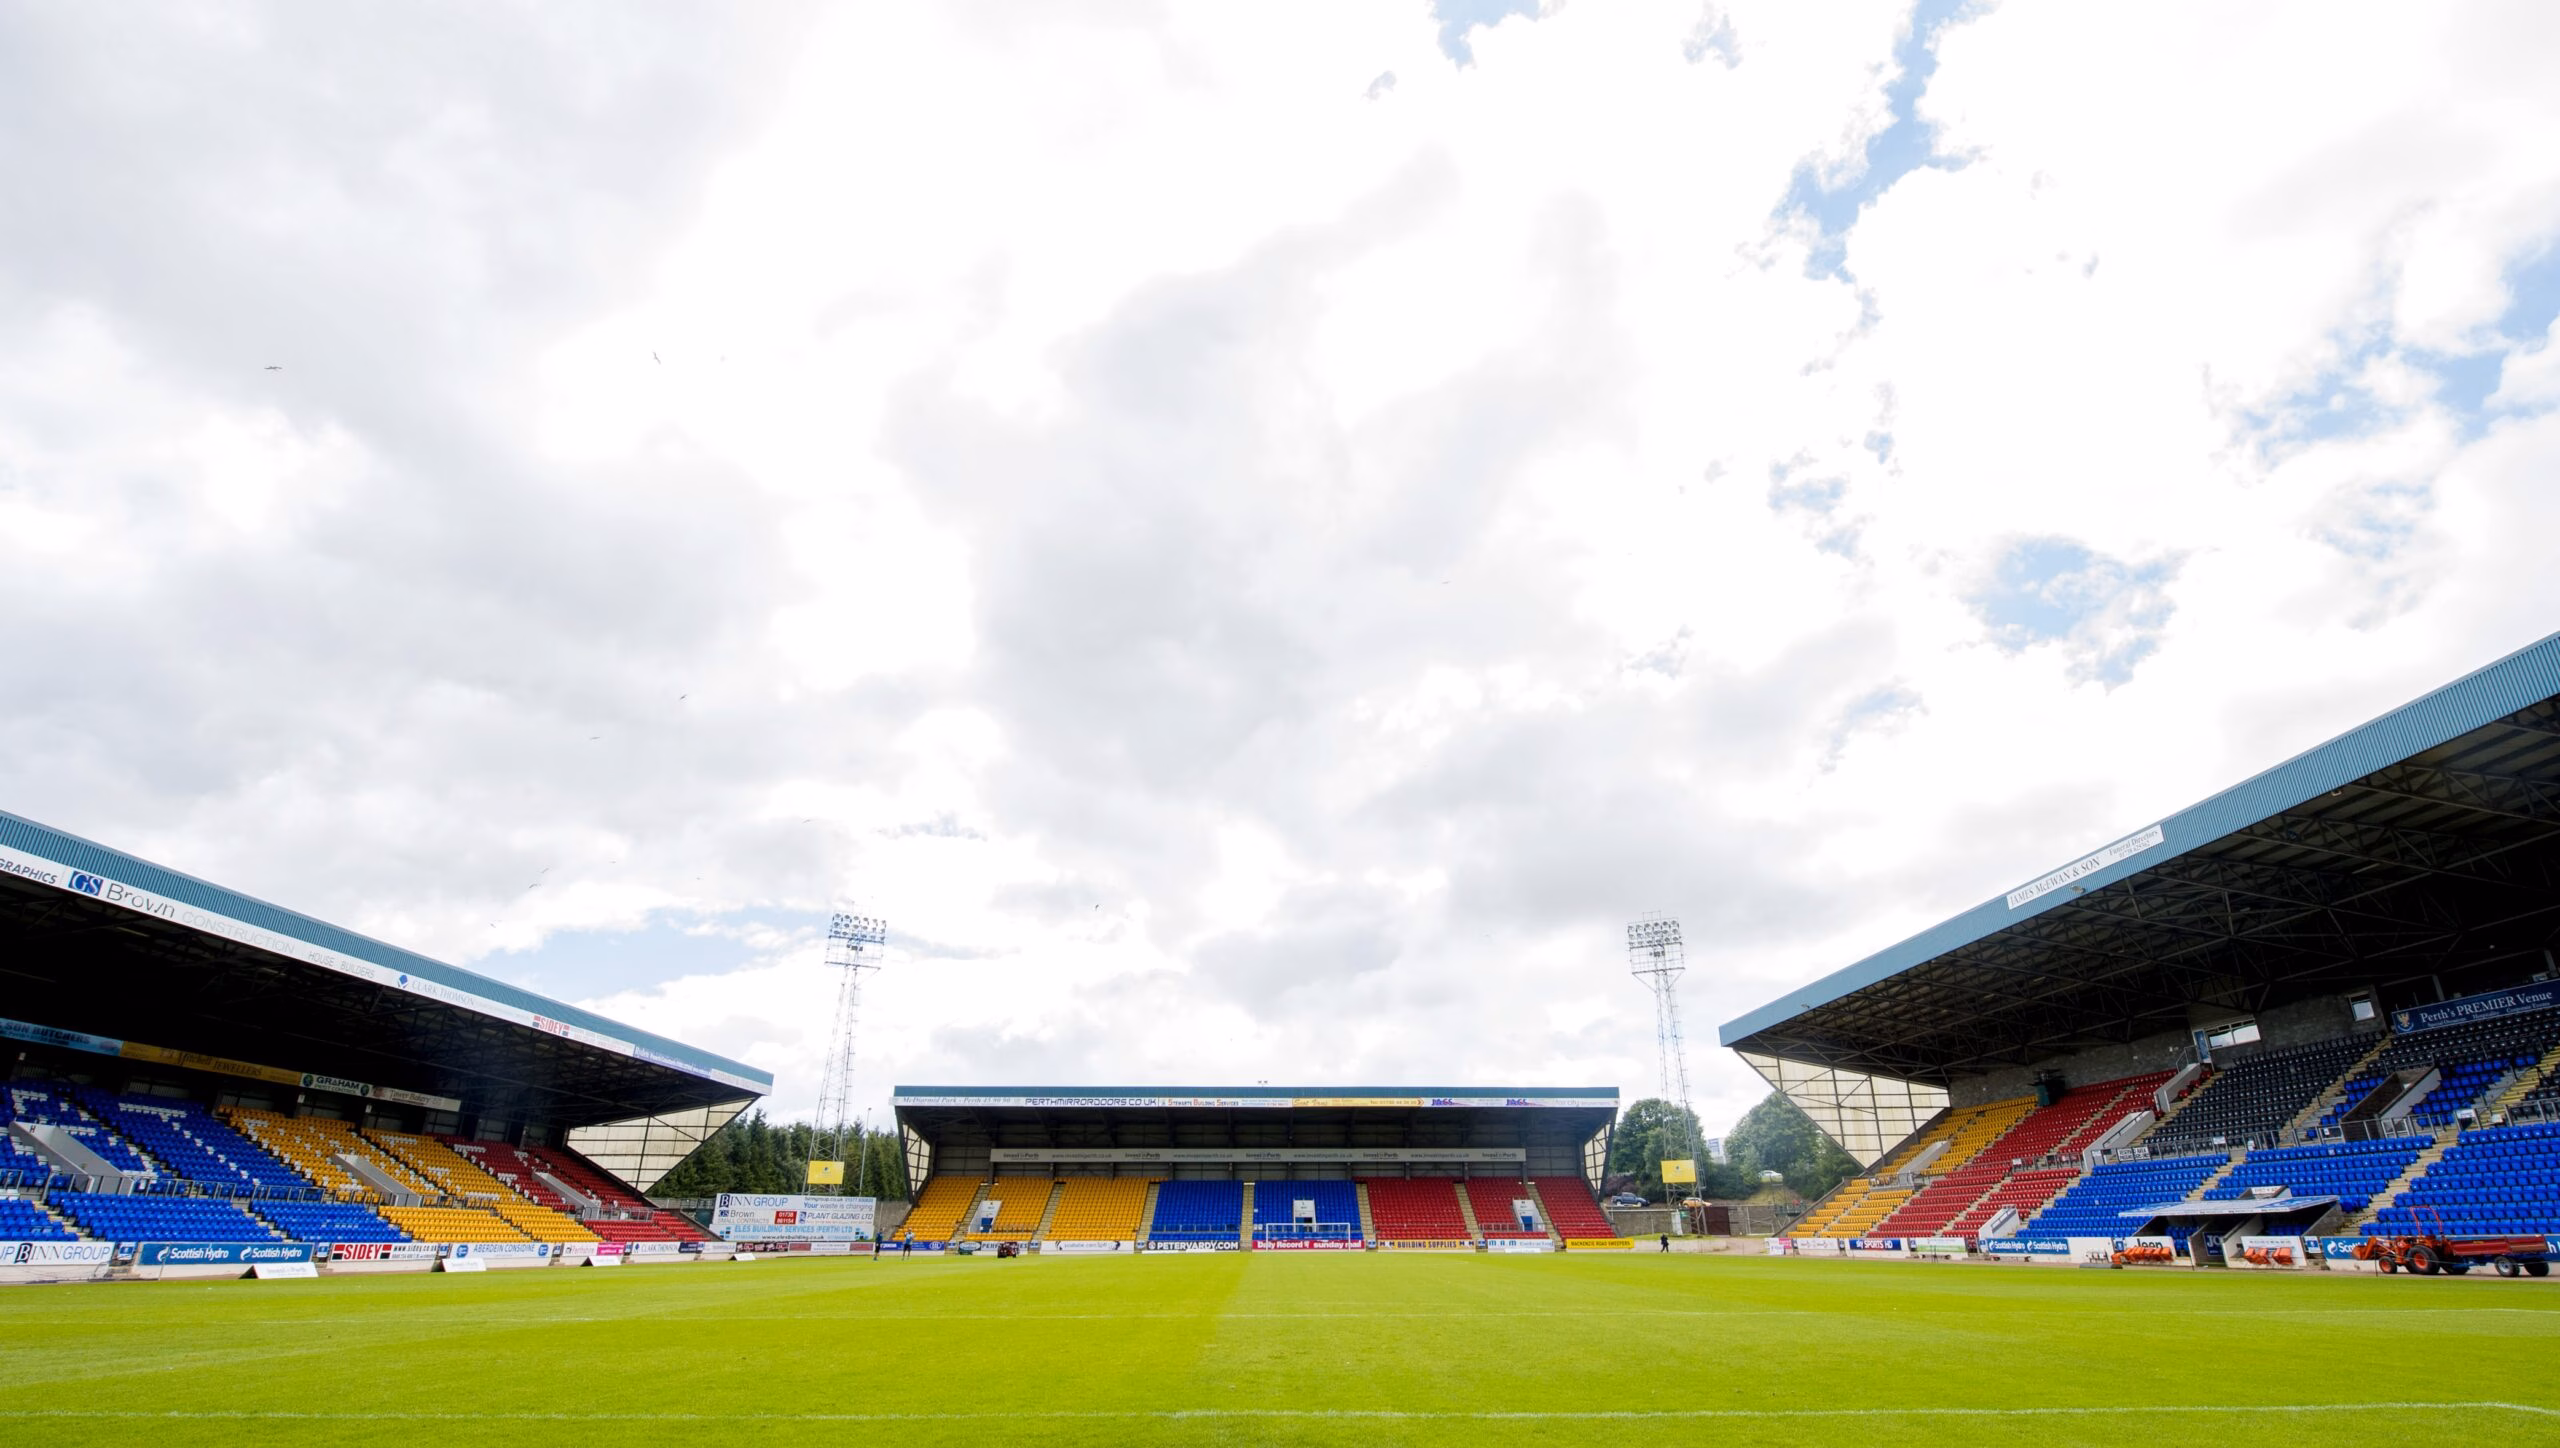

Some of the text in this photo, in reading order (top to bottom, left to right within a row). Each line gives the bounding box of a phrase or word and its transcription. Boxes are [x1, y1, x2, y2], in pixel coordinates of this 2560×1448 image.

[0, 858, 58, 884] GRAPHICS
[2081, 856, 2100, 874] SON
[71, 872, 101, 897] GS
[107, 883, 175, 918] Brown
[182, 910, 295, 954] CONSTRUCTION
[308, 951, 335, 968] HOUSE
[2420, 991, 2552, 1023] Perth's PREMIER Venue
[538, 1017, 564, 1035] SIDEY
[32, 1027, 90, 1044] BUTCHERS
[316, 1076, 360, 1089] GRAHAM
[720, 1194, 788, 1208] BINN GROUP
[846, 1203, 873, 1211] changing
[730, 1210, 755, 1218] Brown
[1157, 1241, 1238, 1250] PETERVARDY.COM
[1257, 1240, 1303, 1250] Daily Record
[1313, 1241, 1343, 1250] sunday
[1864, 1239, 1884, 1249] SPORTS
[1885, 1240, 1893, 1248] HD
[1994, 1241, 2025, 1250] Scottish Hydro
[2033, 1241, 2068, 1251] Scottish Hydro
[63, 1246, 111, 1260] GROUP
[170, 1247, 229, 1261] Scottish Hydro
[252, 1247, 302, 1260] Scottish Hydro
[343, 1244, 382, 1260] SIDEY
